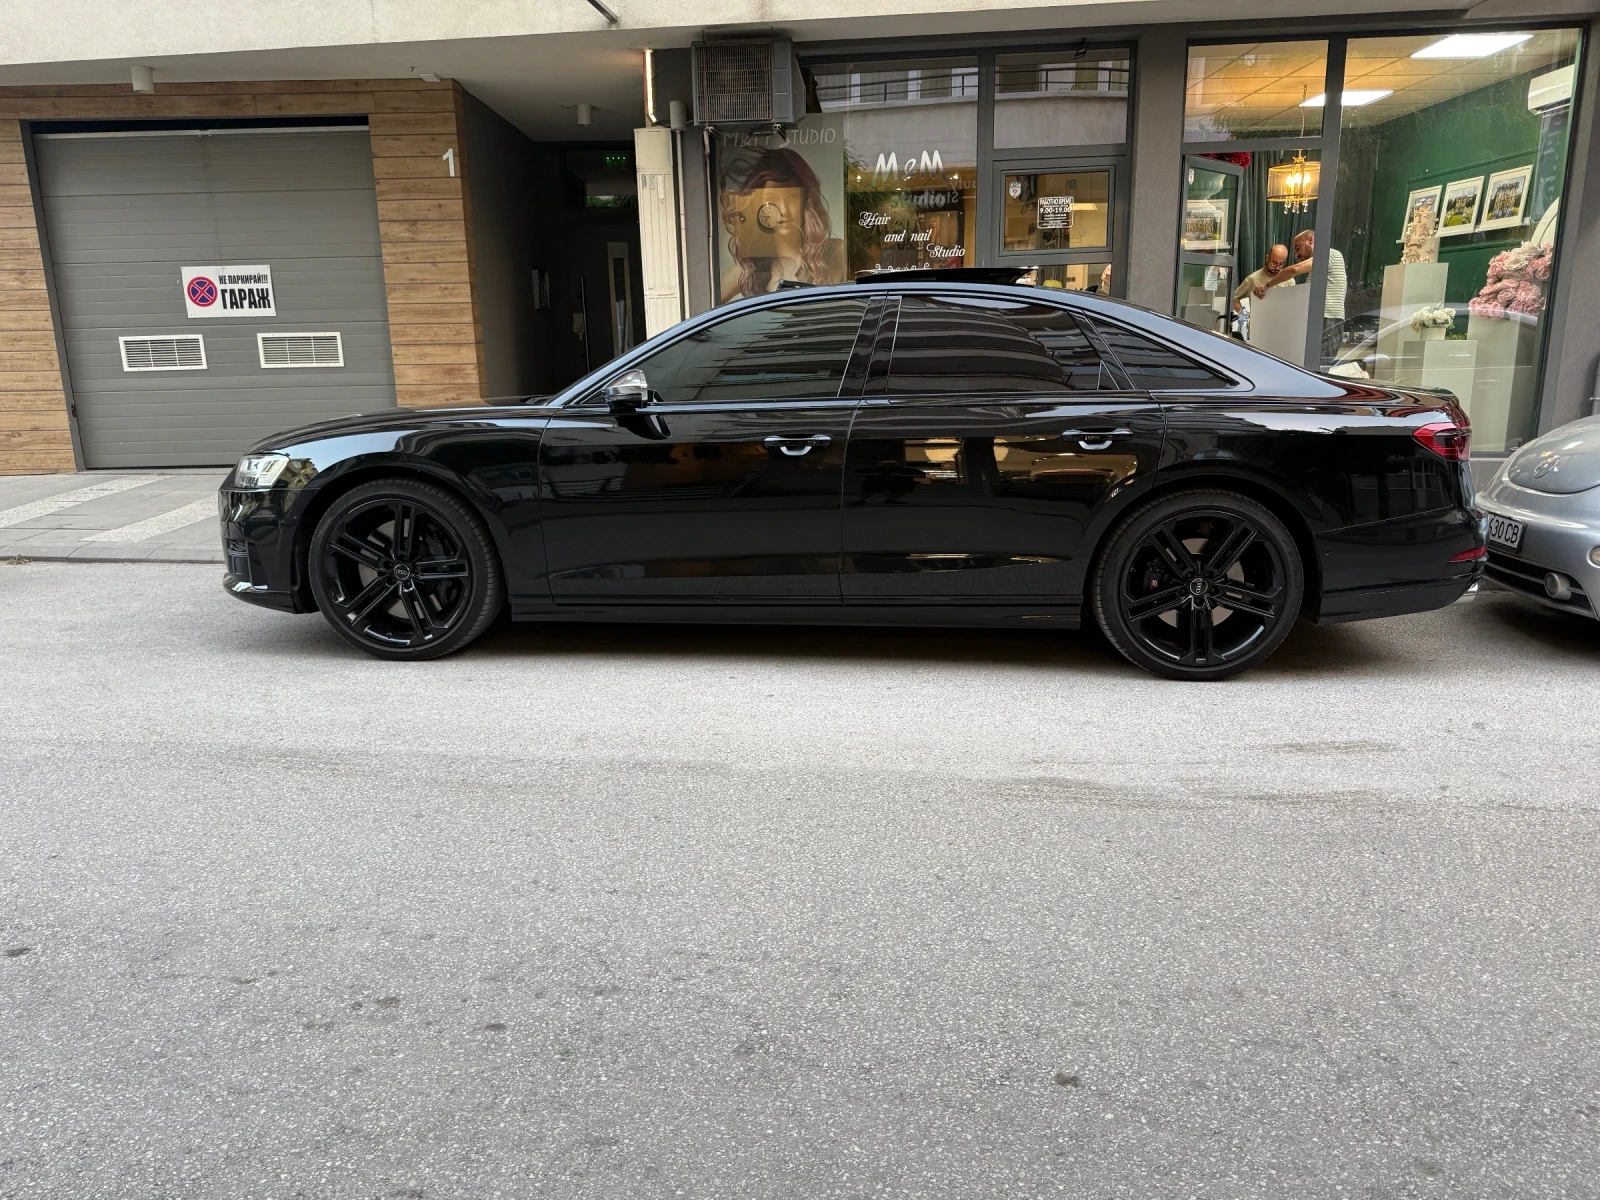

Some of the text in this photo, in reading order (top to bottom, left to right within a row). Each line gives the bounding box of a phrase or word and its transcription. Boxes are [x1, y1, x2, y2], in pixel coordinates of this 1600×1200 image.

[442, 148, 455, 177] 1
[858, 211, 891, 229] Hair
[884, 228, 933, 243] and nail
[926, 243, 966, 258] Studio
[219, 272, 269, 285] НЕ ПАРКИРАЙ!!!
[220, 288, 272, 310] ГАРАЖ
